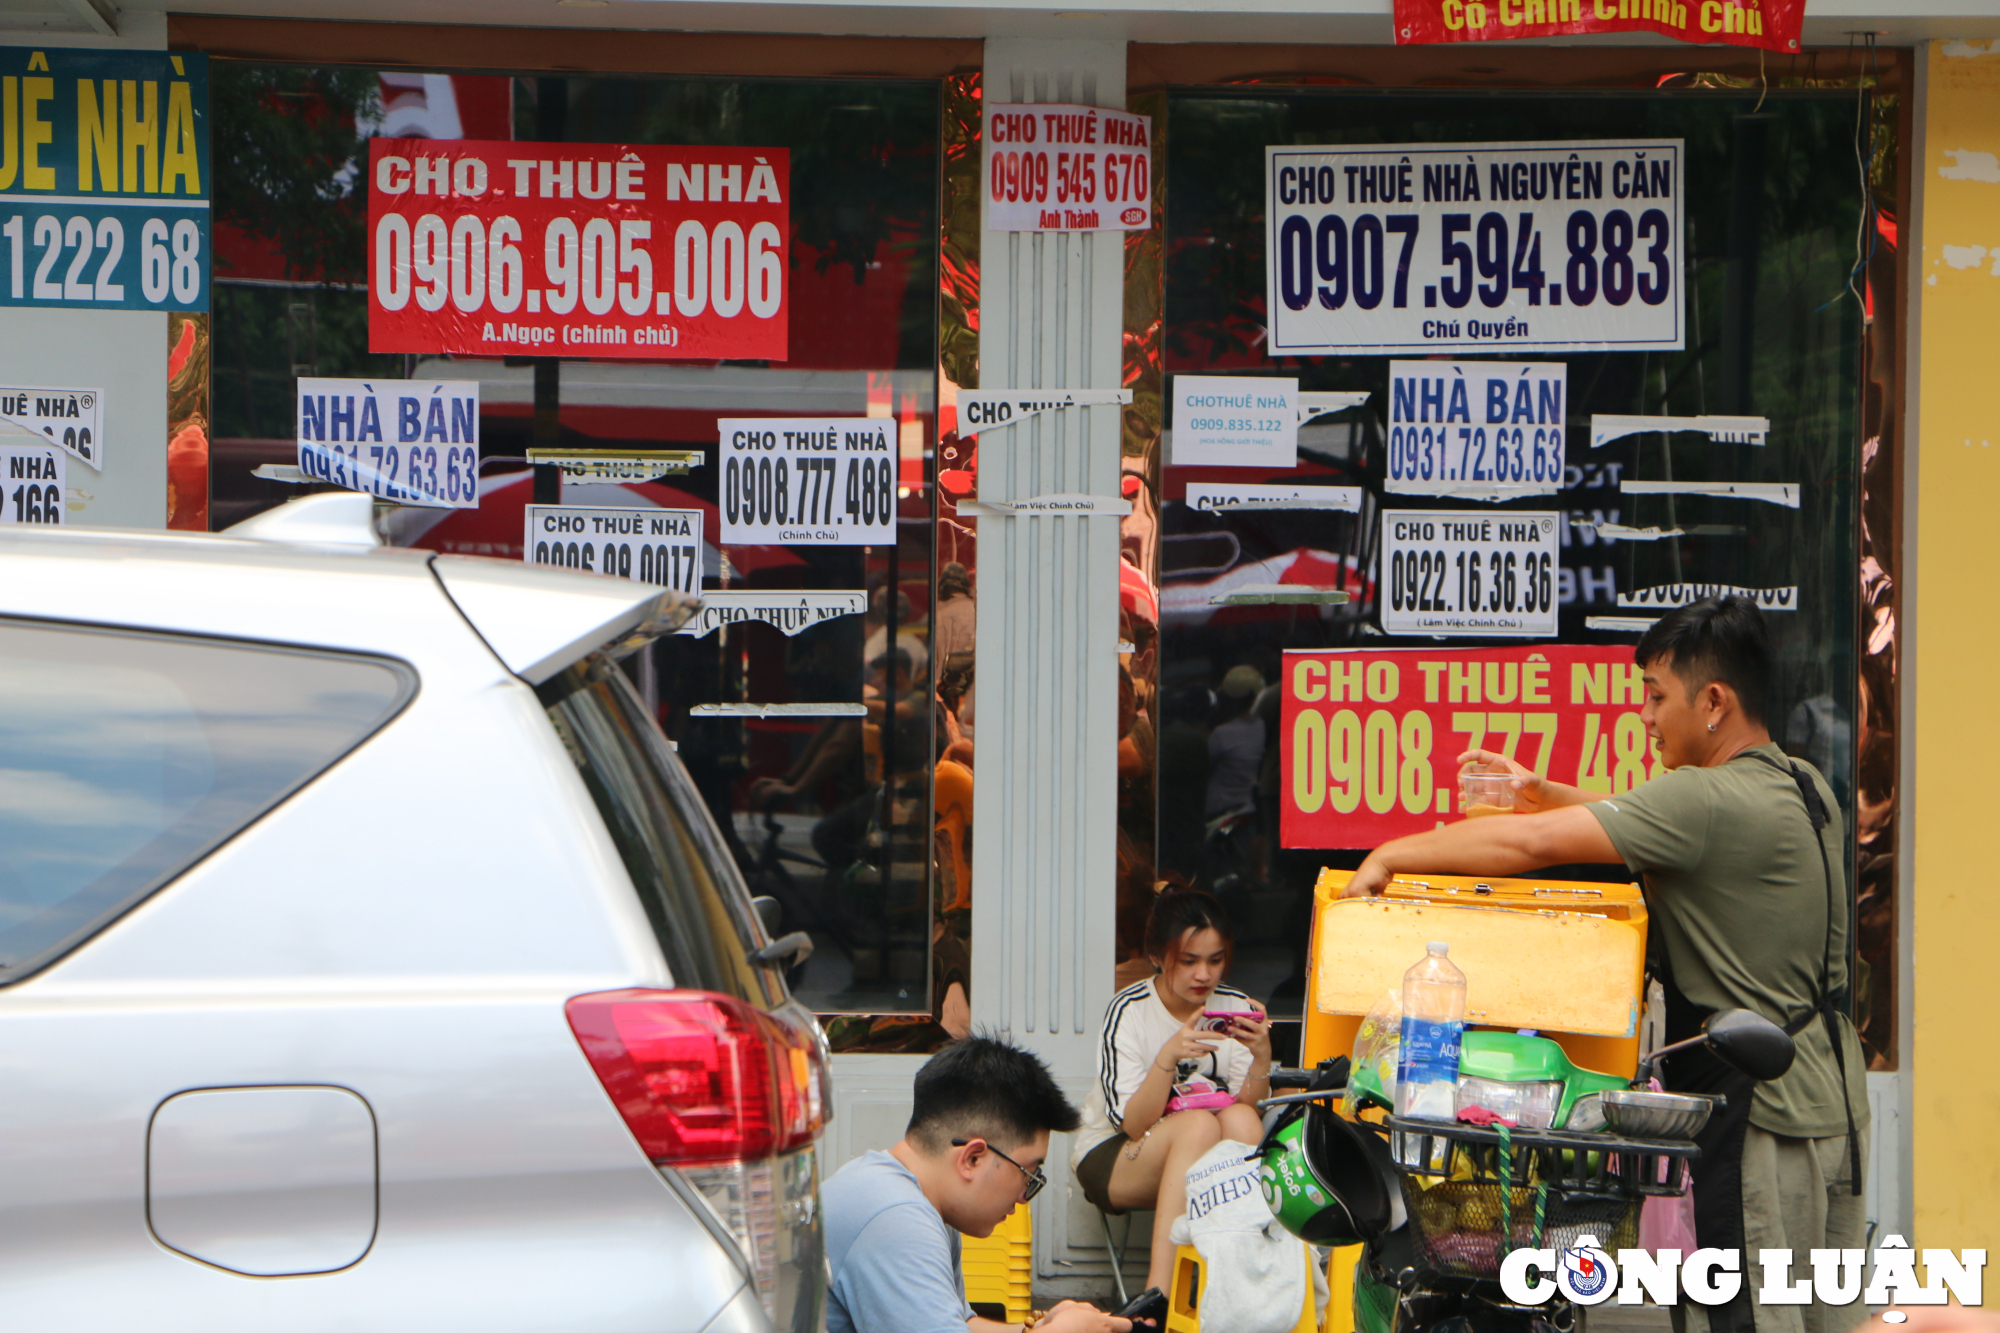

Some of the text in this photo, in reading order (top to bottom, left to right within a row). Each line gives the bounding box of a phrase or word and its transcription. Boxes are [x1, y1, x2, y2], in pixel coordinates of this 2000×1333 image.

[1700, 1, 1763, 36] Chủ
[77, 55, 201, 194] NHÀ
[991, 110, 1148, 147] CHO THUÊ NHÀ
[376, 153, 782, 204] CHO THUÊ NHÀ
[991, 151, 1148, 203] 0909 545 670
[1279, 152, 1671, 204] CHO THUÊ NHÀ NGUYÊN CĂN
[1039, 208, 1099, 229] Anh Thành
[1125, 211, 1143, 222] SGH
[141, 218, 201, 305] 68
[375, 213, 782, 319] 0906.905.006
[1280, 208, 1671, 311] 0907.594.883
[482, 321, 679, 347] A.Ngọc (chính chủ)
[1422, 315, 1529, 340] Chú Quyền
[303, 384, 475, 443] NHÀ BÁN
[967, 401, 1012, 424] CHO
[1186, 394, 1288, 409] CHOTHUÊ NHÀ
[1393, 366, 1562, 424] NHÀ BÁN
[732, 426, 888, 451] CHO THUÊ NHÀ
[1190, 418, 1282, 431] 0909.835.122
[10, 452, 57, 480] NHÀ
[1390, 426, 1562, 483] 0931.72.63.63
[726, 456, 892, 526] 0908.777.488
[544, 514, 691, 536] CHO THUÊ NHÀ
[779, 531, 839, 541] (Chính Chủ)
[1395, 521, 1435, 541] CHO
[1443, 520, 1492, 541] THUÊ
[1392, 550, 1552, 613] 0922.16.36.36
[1293, 653, 1648, 704] CHO THUÊ NH
[1276, 1152, 1302, 1197] gojek
